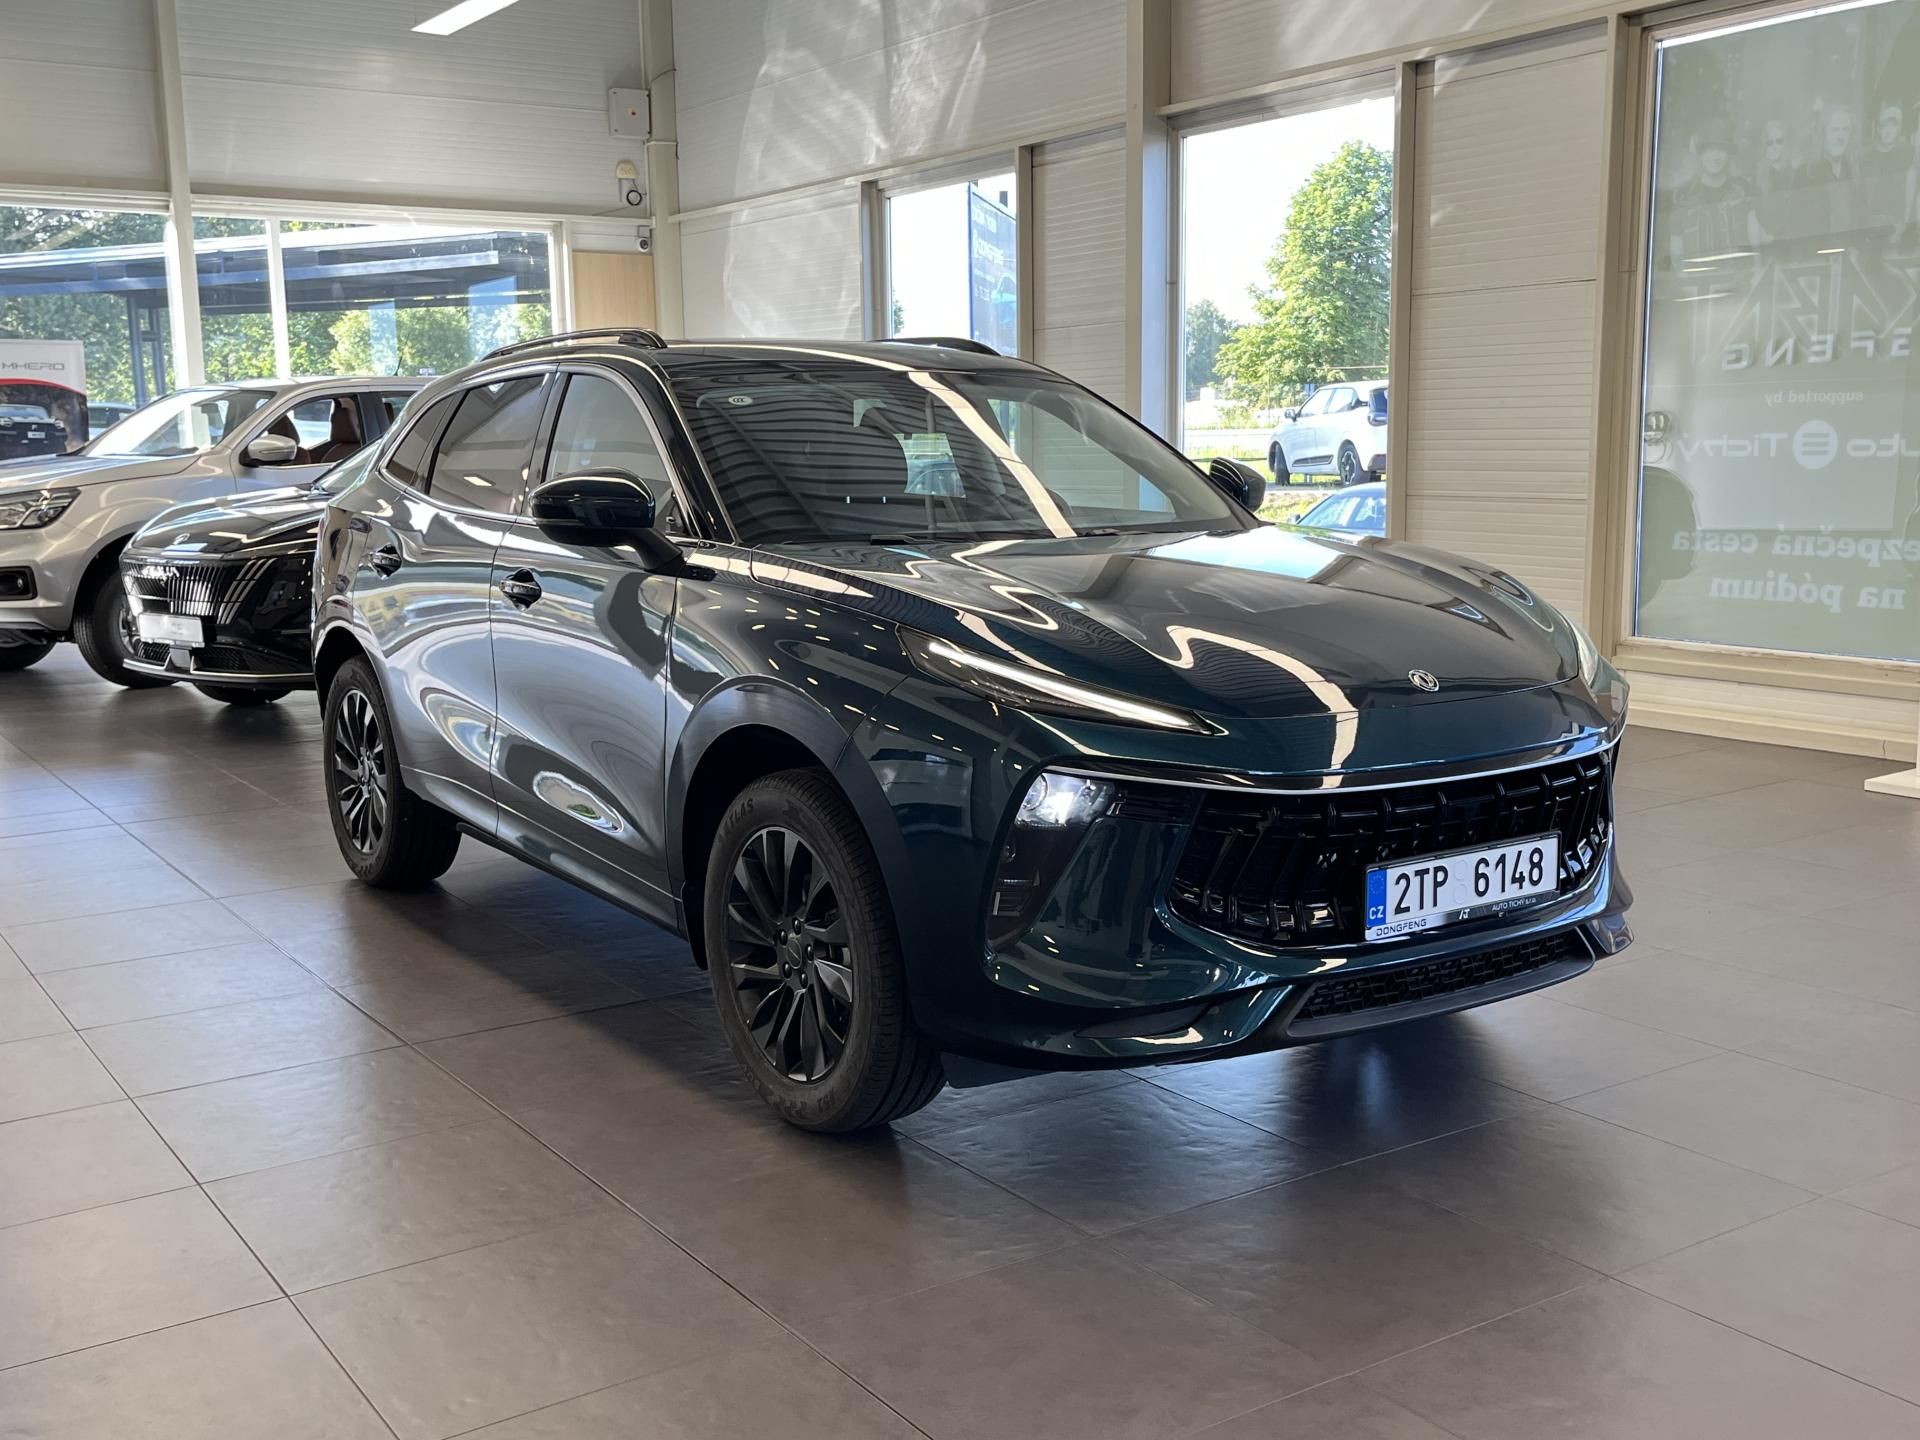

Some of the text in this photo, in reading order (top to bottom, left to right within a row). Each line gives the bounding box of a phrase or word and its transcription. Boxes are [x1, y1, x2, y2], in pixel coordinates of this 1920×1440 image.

[2, 361, 65, 371] MHERO
[1394, 847, 1544, 916] 2TP 6148
[1369, 905, 1384, 920] CZ
[1492, 901, 1508, 912] AUTO
[1376, 918, 1427, 937] DONGFENG
